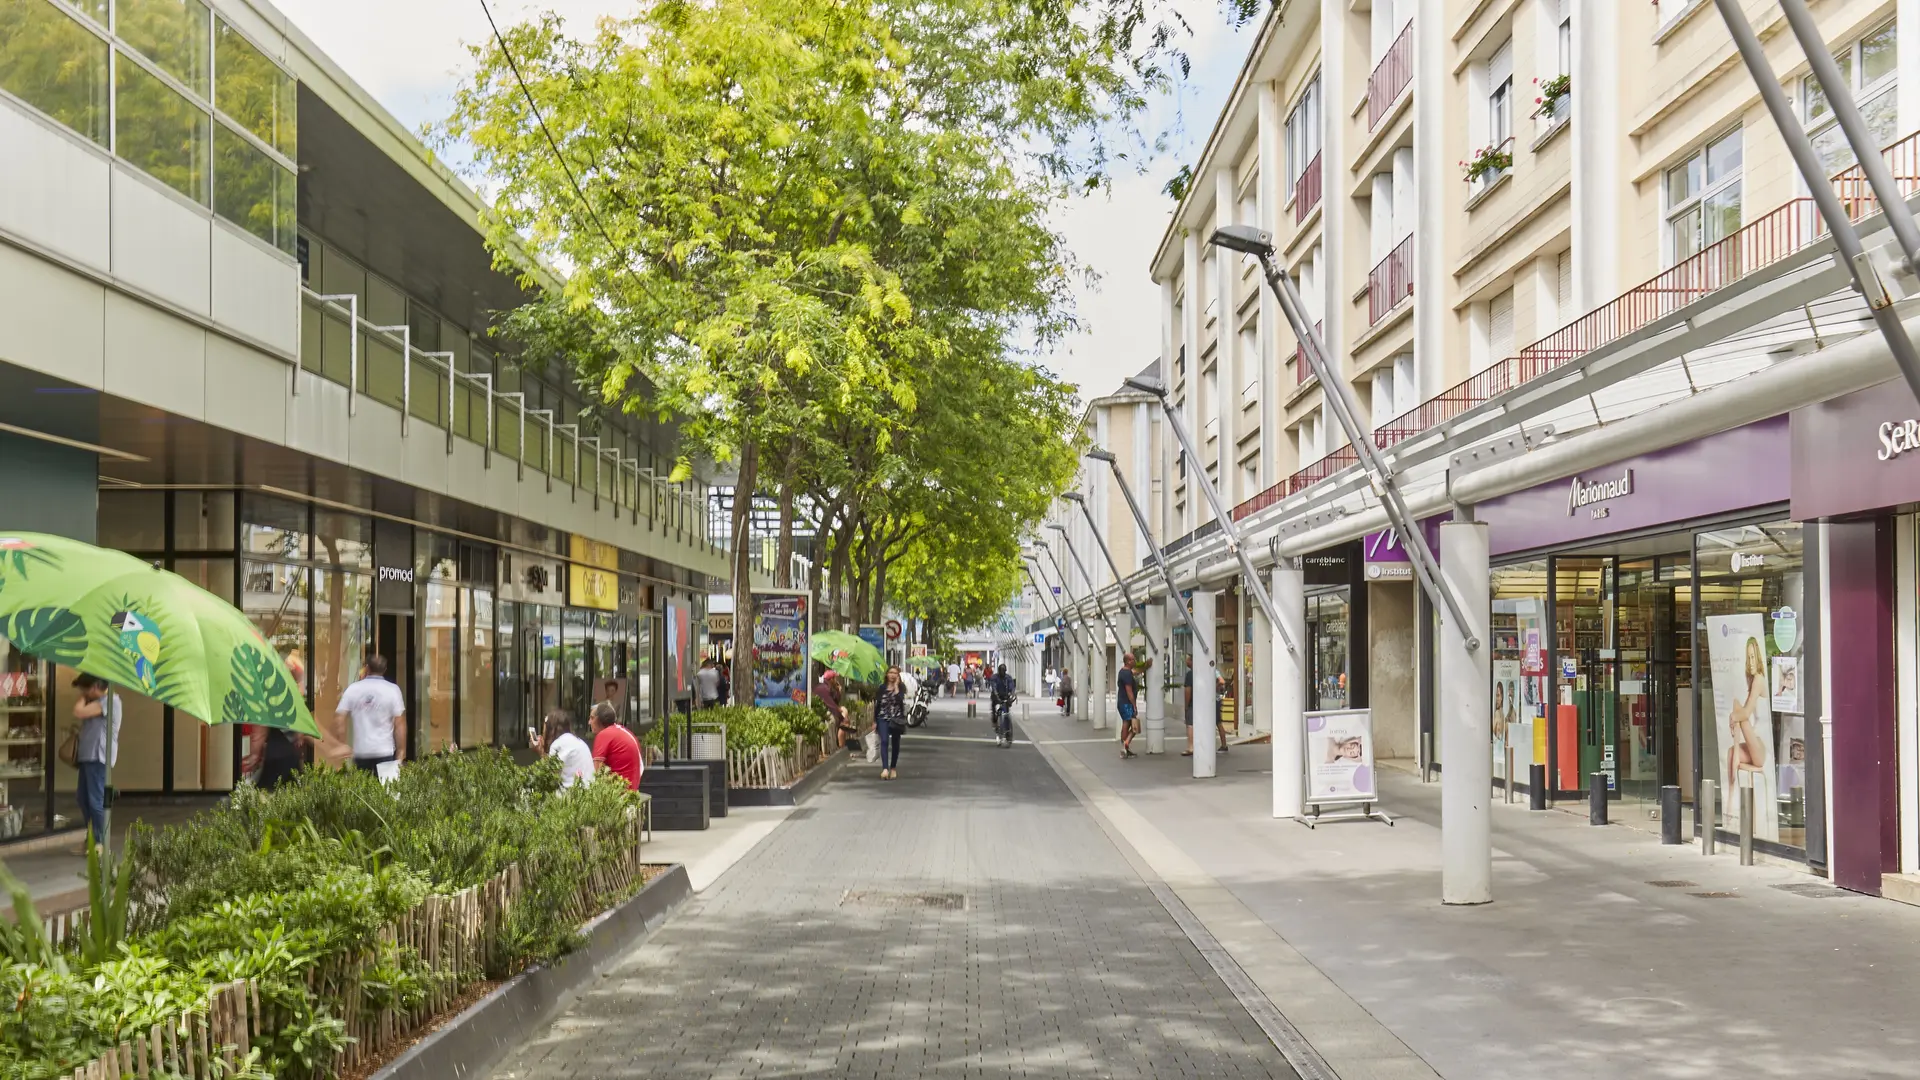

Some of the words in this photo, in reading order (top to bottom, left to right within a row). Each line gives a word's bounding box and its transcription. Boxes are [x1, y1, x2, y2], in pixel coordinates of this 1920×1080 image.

[1877, 419, 1920, 461] SeR
[1566, 469, 1630, 517] Marionnaud
[1590, 507, 1609, 520] PARIS
[1305, 556, 1347, 564] carréblanc
[379, 566, 413, 583] promod
[1381, 567, 1413, 576] Institut
[708, 618, 734, 631] KIOS
